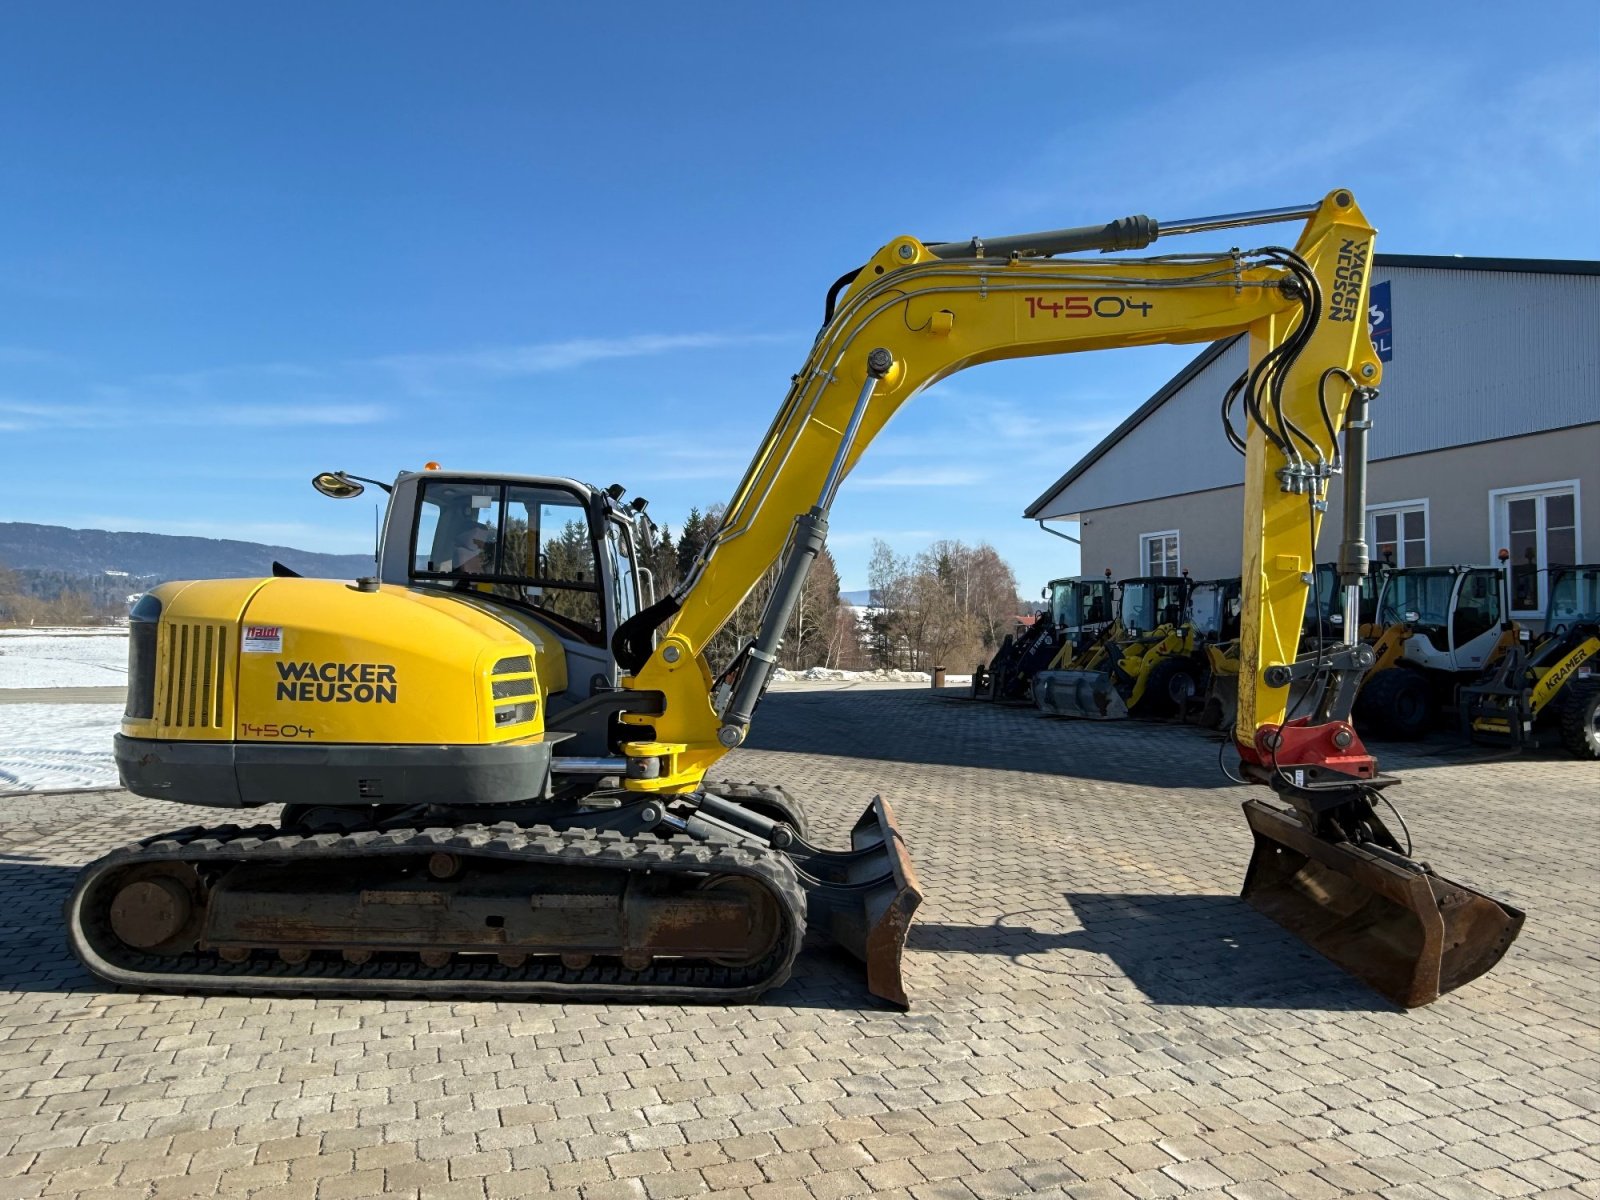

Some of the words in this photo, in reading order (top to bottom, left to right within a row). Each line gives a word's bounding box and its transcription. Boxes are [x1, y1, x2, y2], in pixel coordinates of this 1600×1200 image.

[1328, 238, 1355, 322] NEUSON
[1341, 240, 1369, 322] WACKER
[1024, 296, 1153, 318] 14504
[275, 661, 398, 683] WACKER
[1545, 648, 1587, 690] KRAMER
[276, 681, 397, 704] NEUSON
[241, 723, 315, 739] 14504
